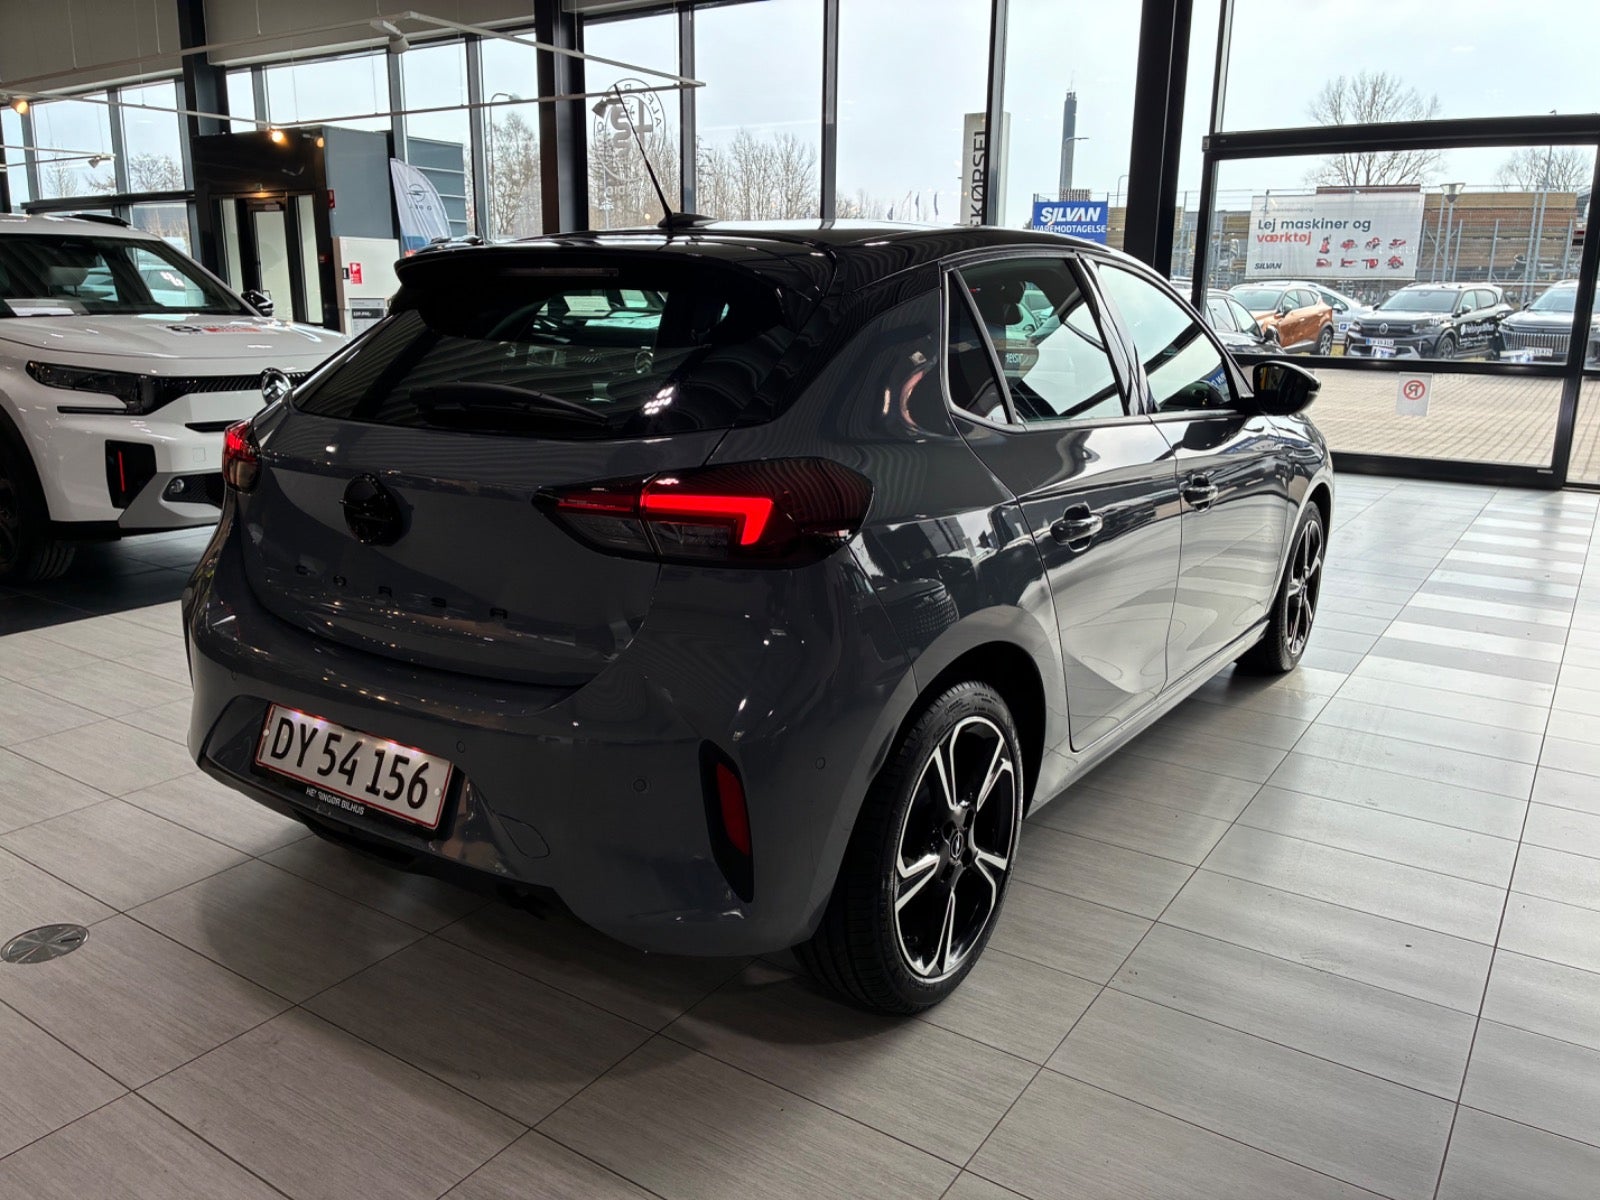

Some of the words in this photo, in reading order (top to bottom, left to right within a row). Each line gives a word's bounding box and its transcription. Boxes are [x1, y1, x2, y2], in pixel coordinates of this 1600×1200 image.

[1040, 207, 1101, 225] SILVAN
[1258, 218, 1276, 233] Lej
[1280, 217, 1348, 231] maskiner
[1352, 220, 1371, 232] og
[1256, 231, 1312, 246] værktøj
[1254, 262, 1282, 270] SILVAN
[271, 716, 319, 768] DY
[317, 732, 364, 786] 54
[365, 749, 430, 809] 156
